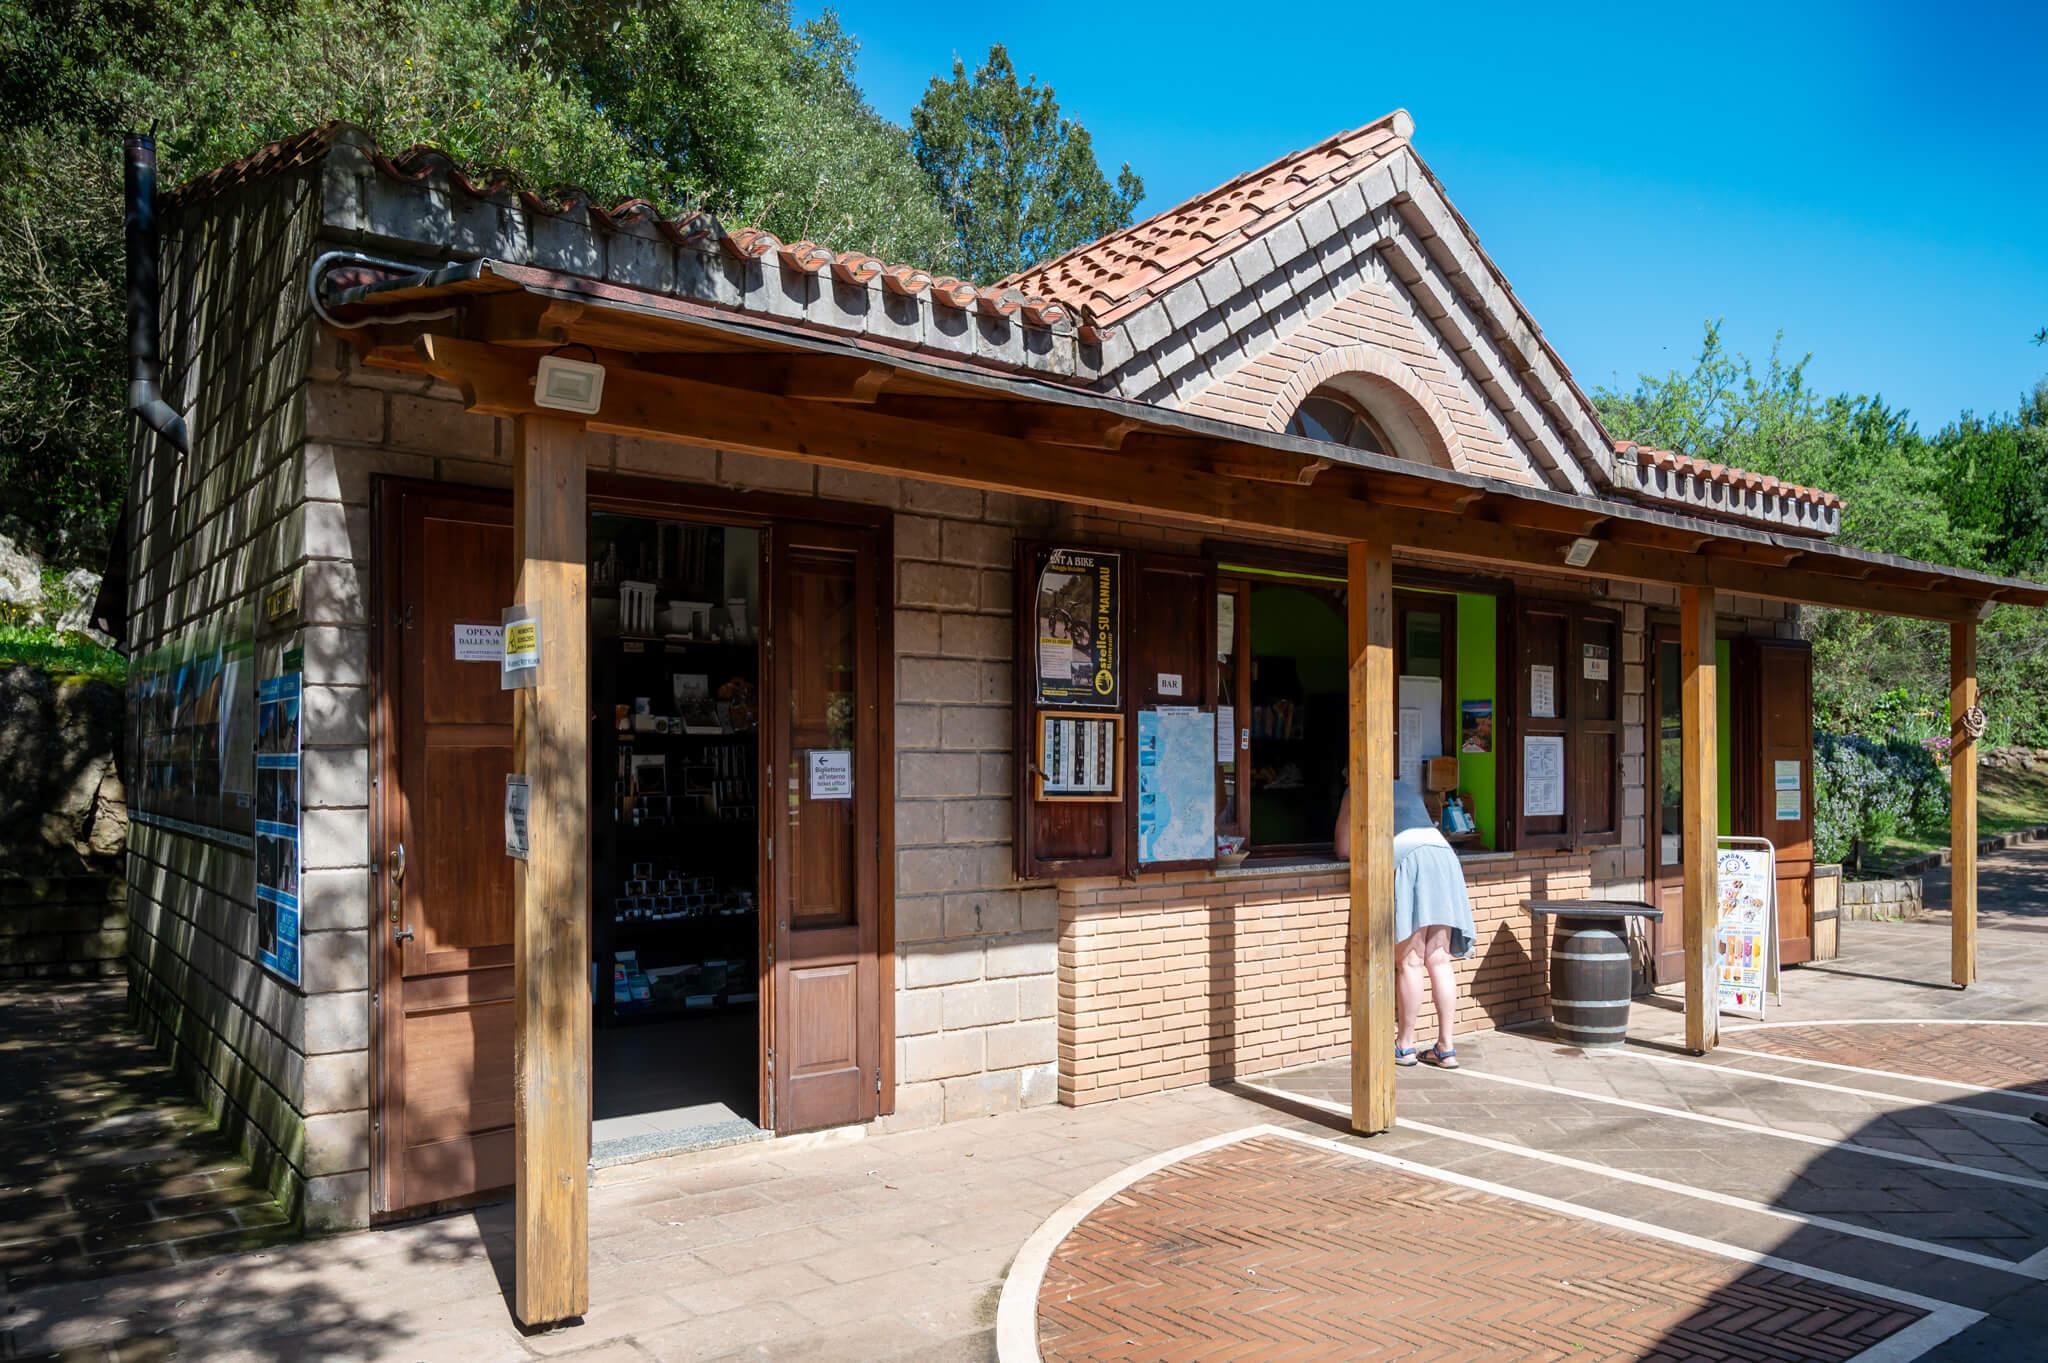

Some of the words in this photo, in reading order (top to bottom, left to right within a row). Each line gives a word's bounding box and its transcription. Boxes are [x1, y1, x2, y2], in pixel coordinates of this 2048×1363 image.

[1066, 557, 1073, 566] A
[1075, 557, 1094, 567] BIKE
[1099, 567, 1110, 614] MANNAU
[1098, 616, 1109, 631] SU
[466, 628, 491, 637] OPEN
[1162, 680, 1177, 688] BAR
